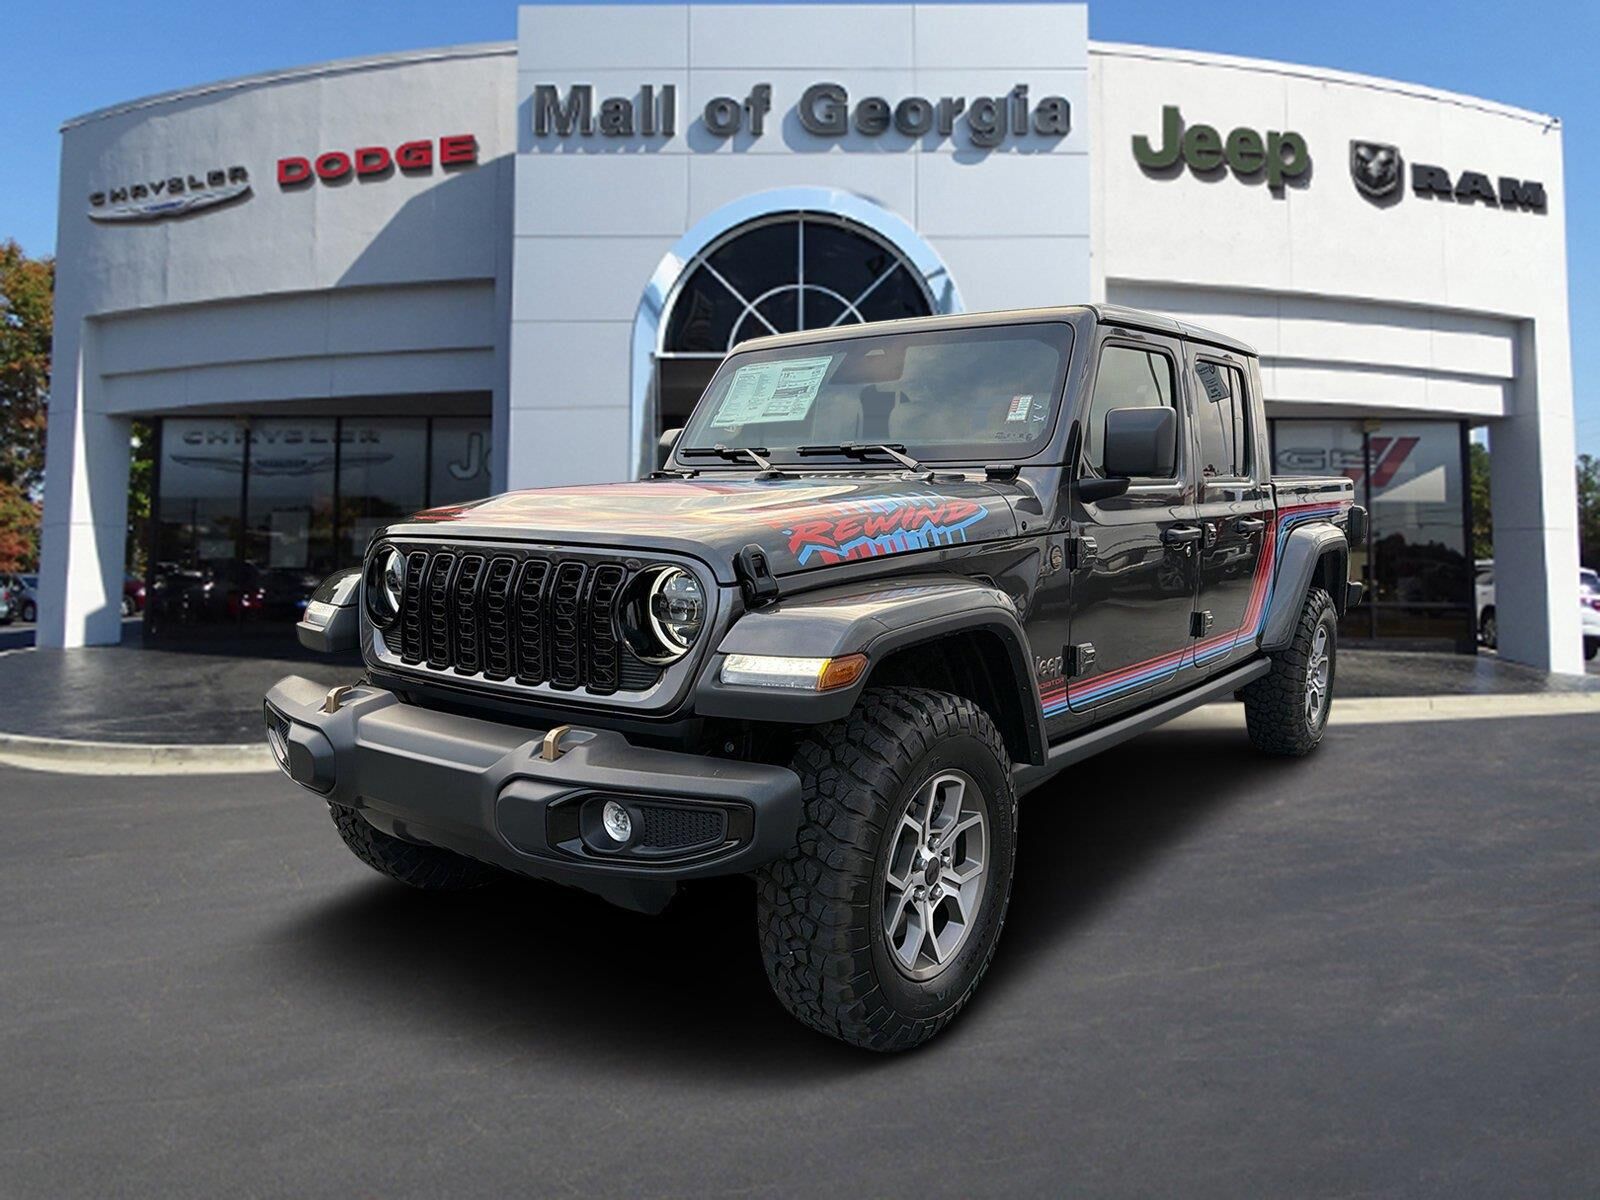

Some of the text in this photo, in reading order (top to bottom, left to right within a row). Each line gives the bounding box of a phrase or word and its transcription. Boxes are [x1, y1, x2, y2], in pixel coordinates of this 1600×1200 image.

[532, 83, 1072, 148] Mall of Georgia
[277, 134, 477, 187] DODGE
[1131, 105, 1309, 195] Jeep
[88, 166, 250, 206] CHRYSLER
[1411, 162, 1548, 214] RAM
[788, 499, 981, 554] REWIND
